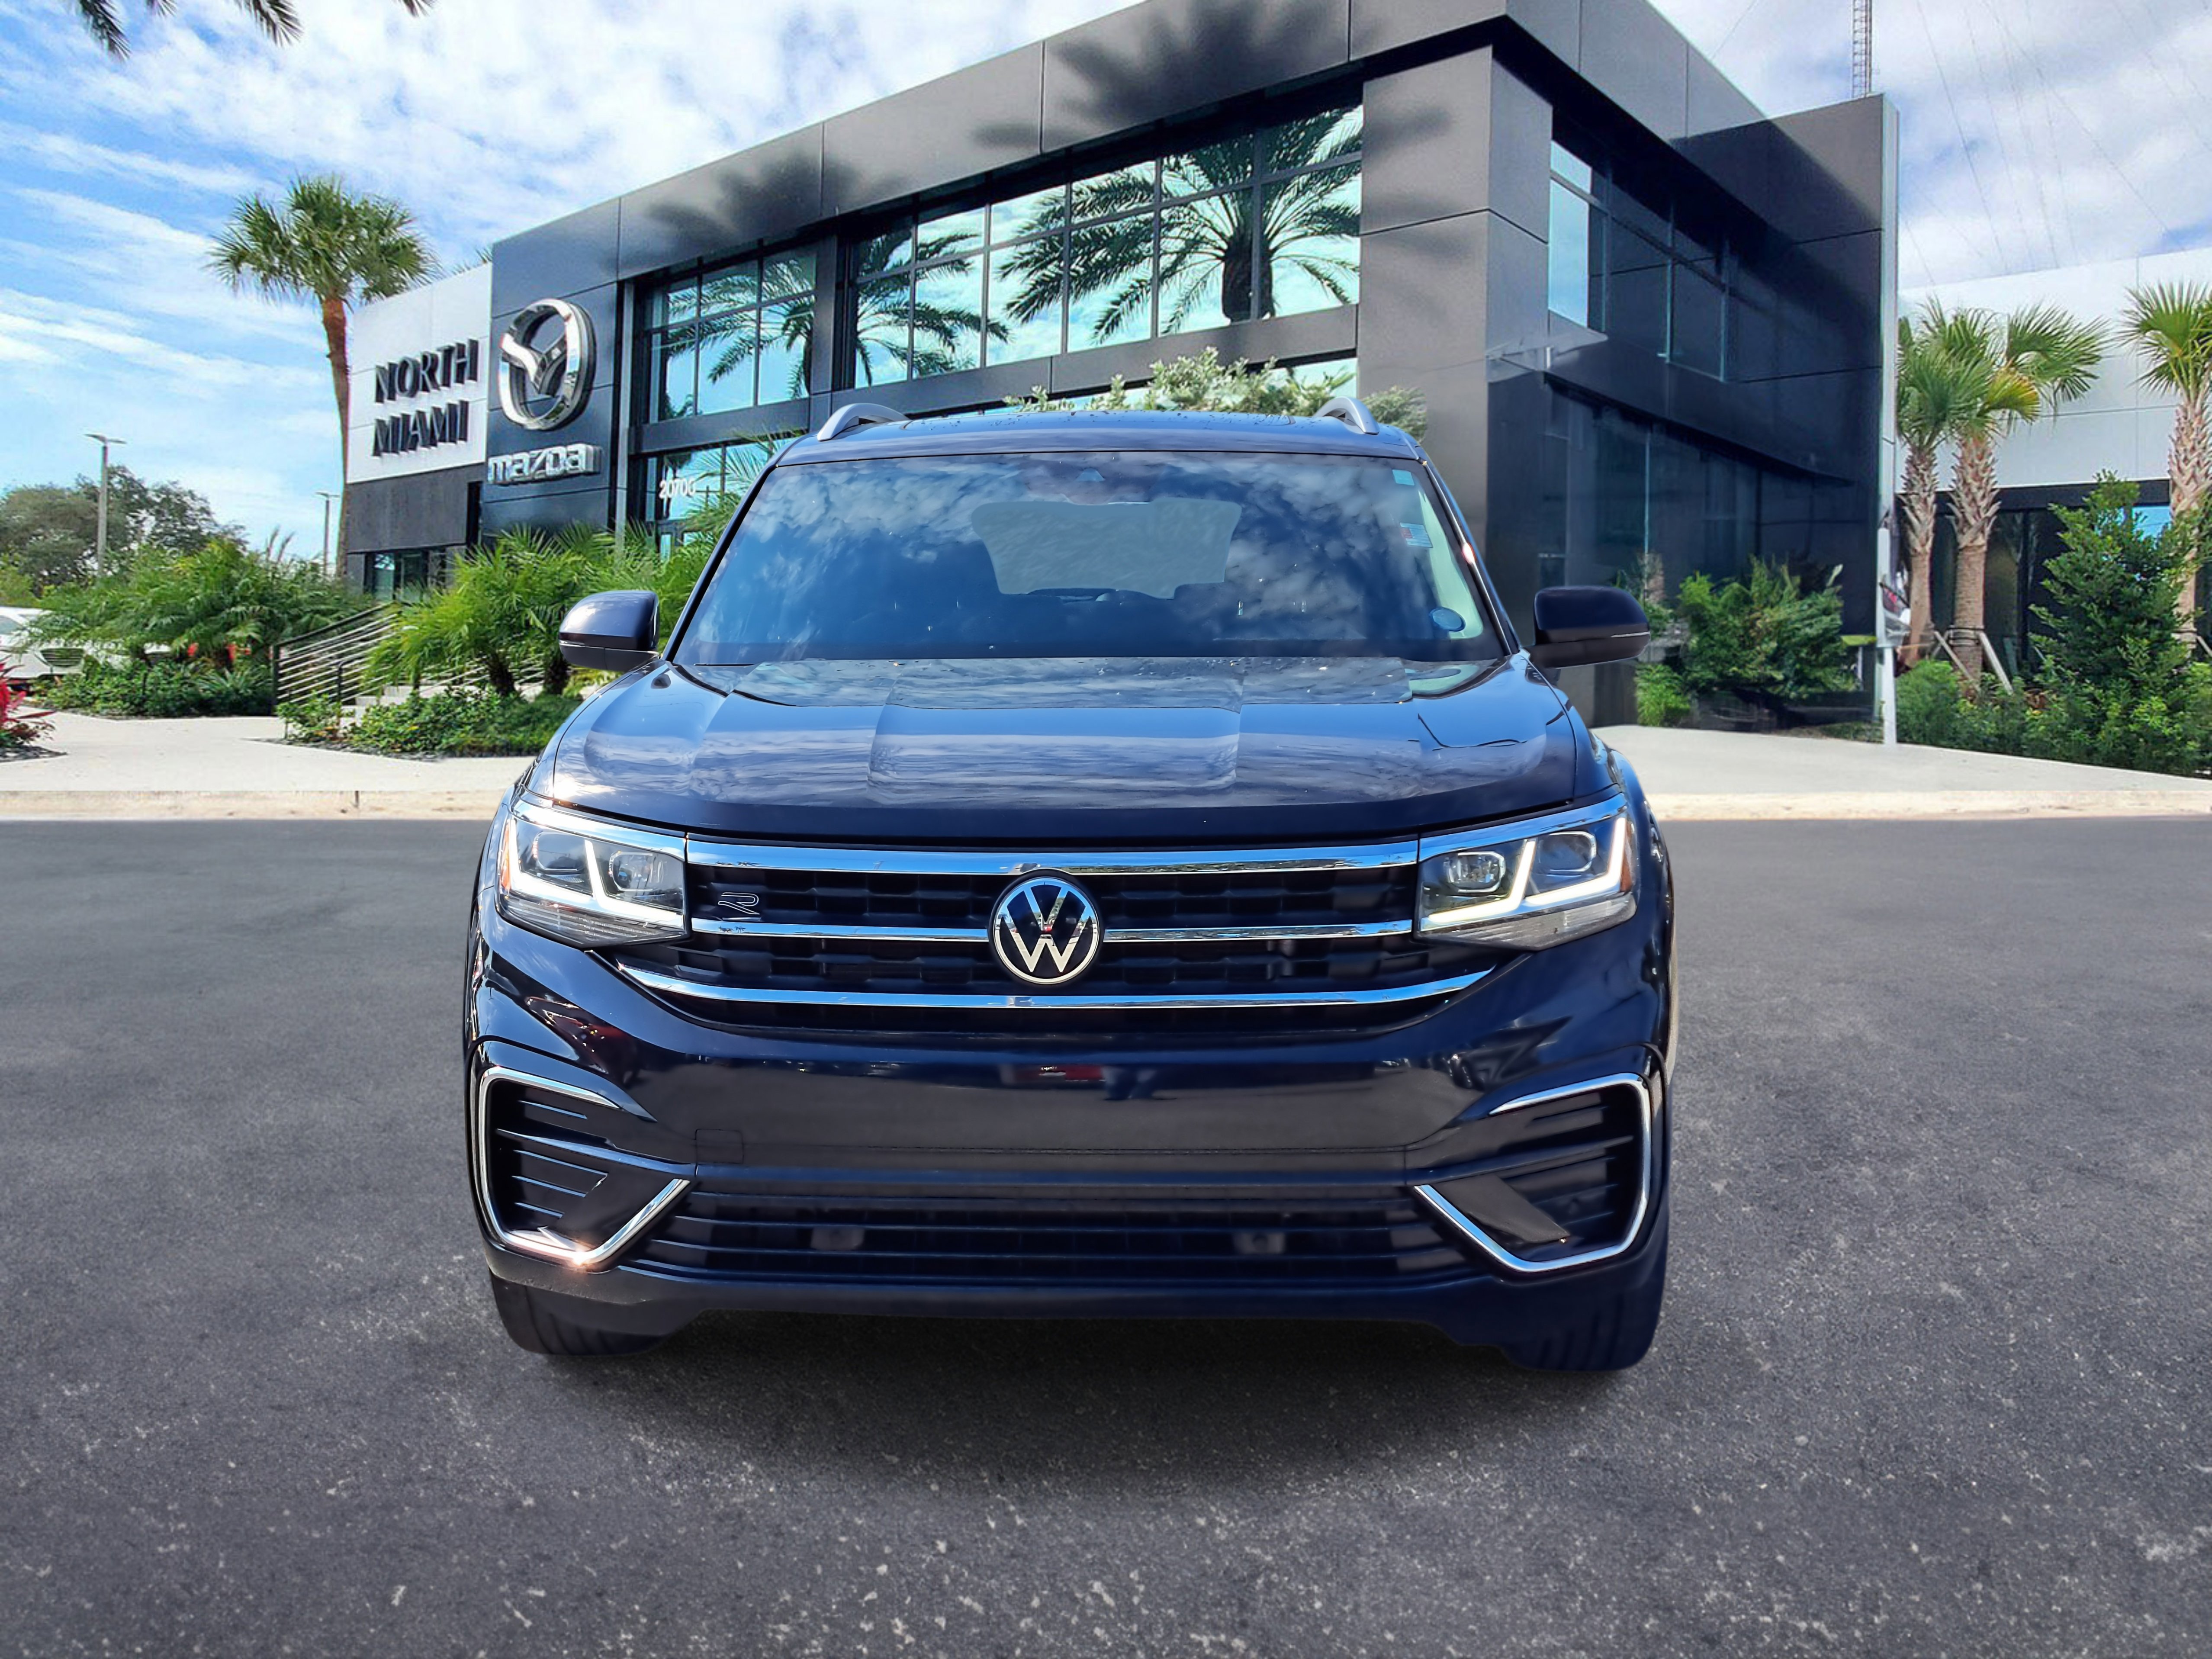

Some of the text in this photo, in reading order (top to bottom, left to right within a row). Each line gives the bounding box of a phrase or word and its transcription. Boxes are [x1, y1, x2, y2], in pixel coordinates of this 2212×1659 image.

[376, 339, 479, 403] NORTH
[373, 400, 469, 457] MIAMI
[488, 444, 601, 485] mazda
[718, 892, 760, 915] R
